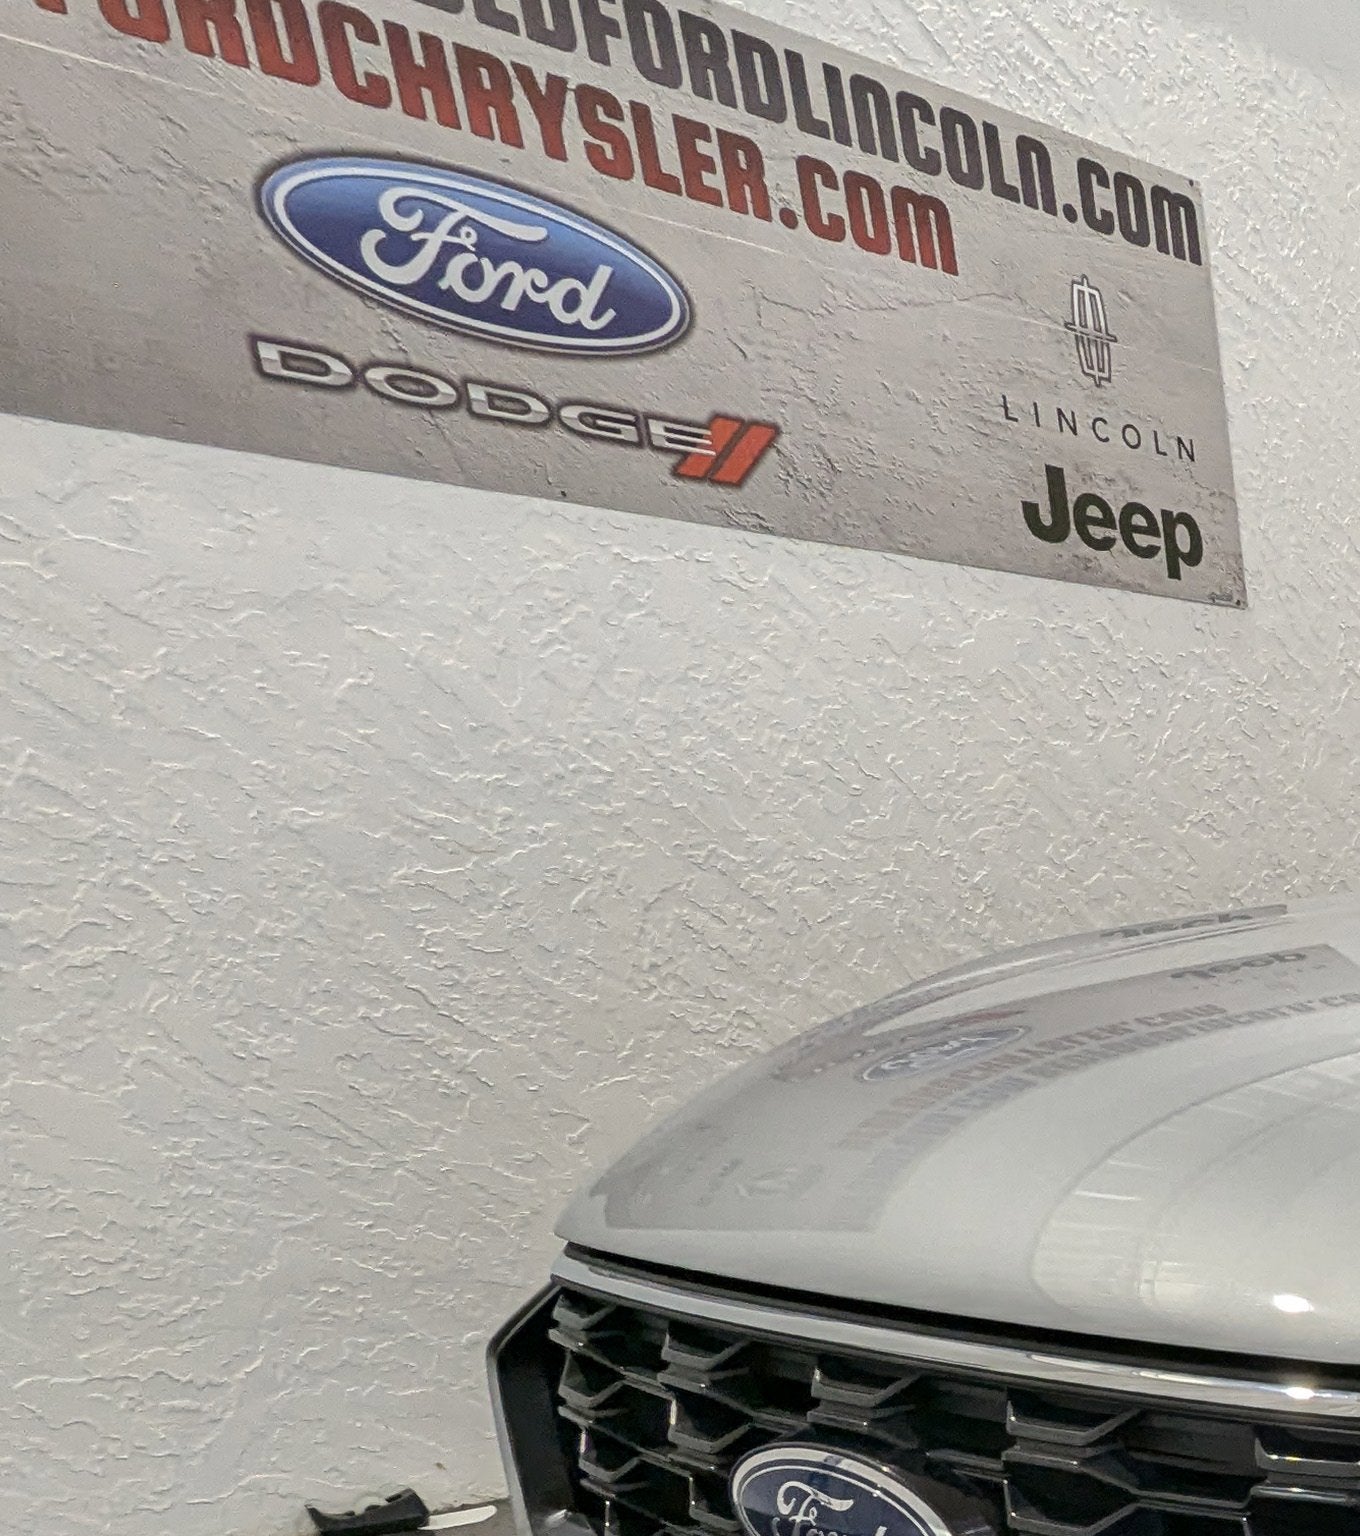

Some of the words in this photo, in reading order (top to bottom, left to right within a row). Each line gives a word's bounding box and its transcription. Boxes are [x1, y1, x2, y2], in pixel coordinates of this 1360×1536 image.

[360, 187, 616, 331] Ford
[255, 338, 718, 459] DODGE
[1001, 394, 1196, 462] LINCOLN
[1021, 463, 1204, 581] Jeep
